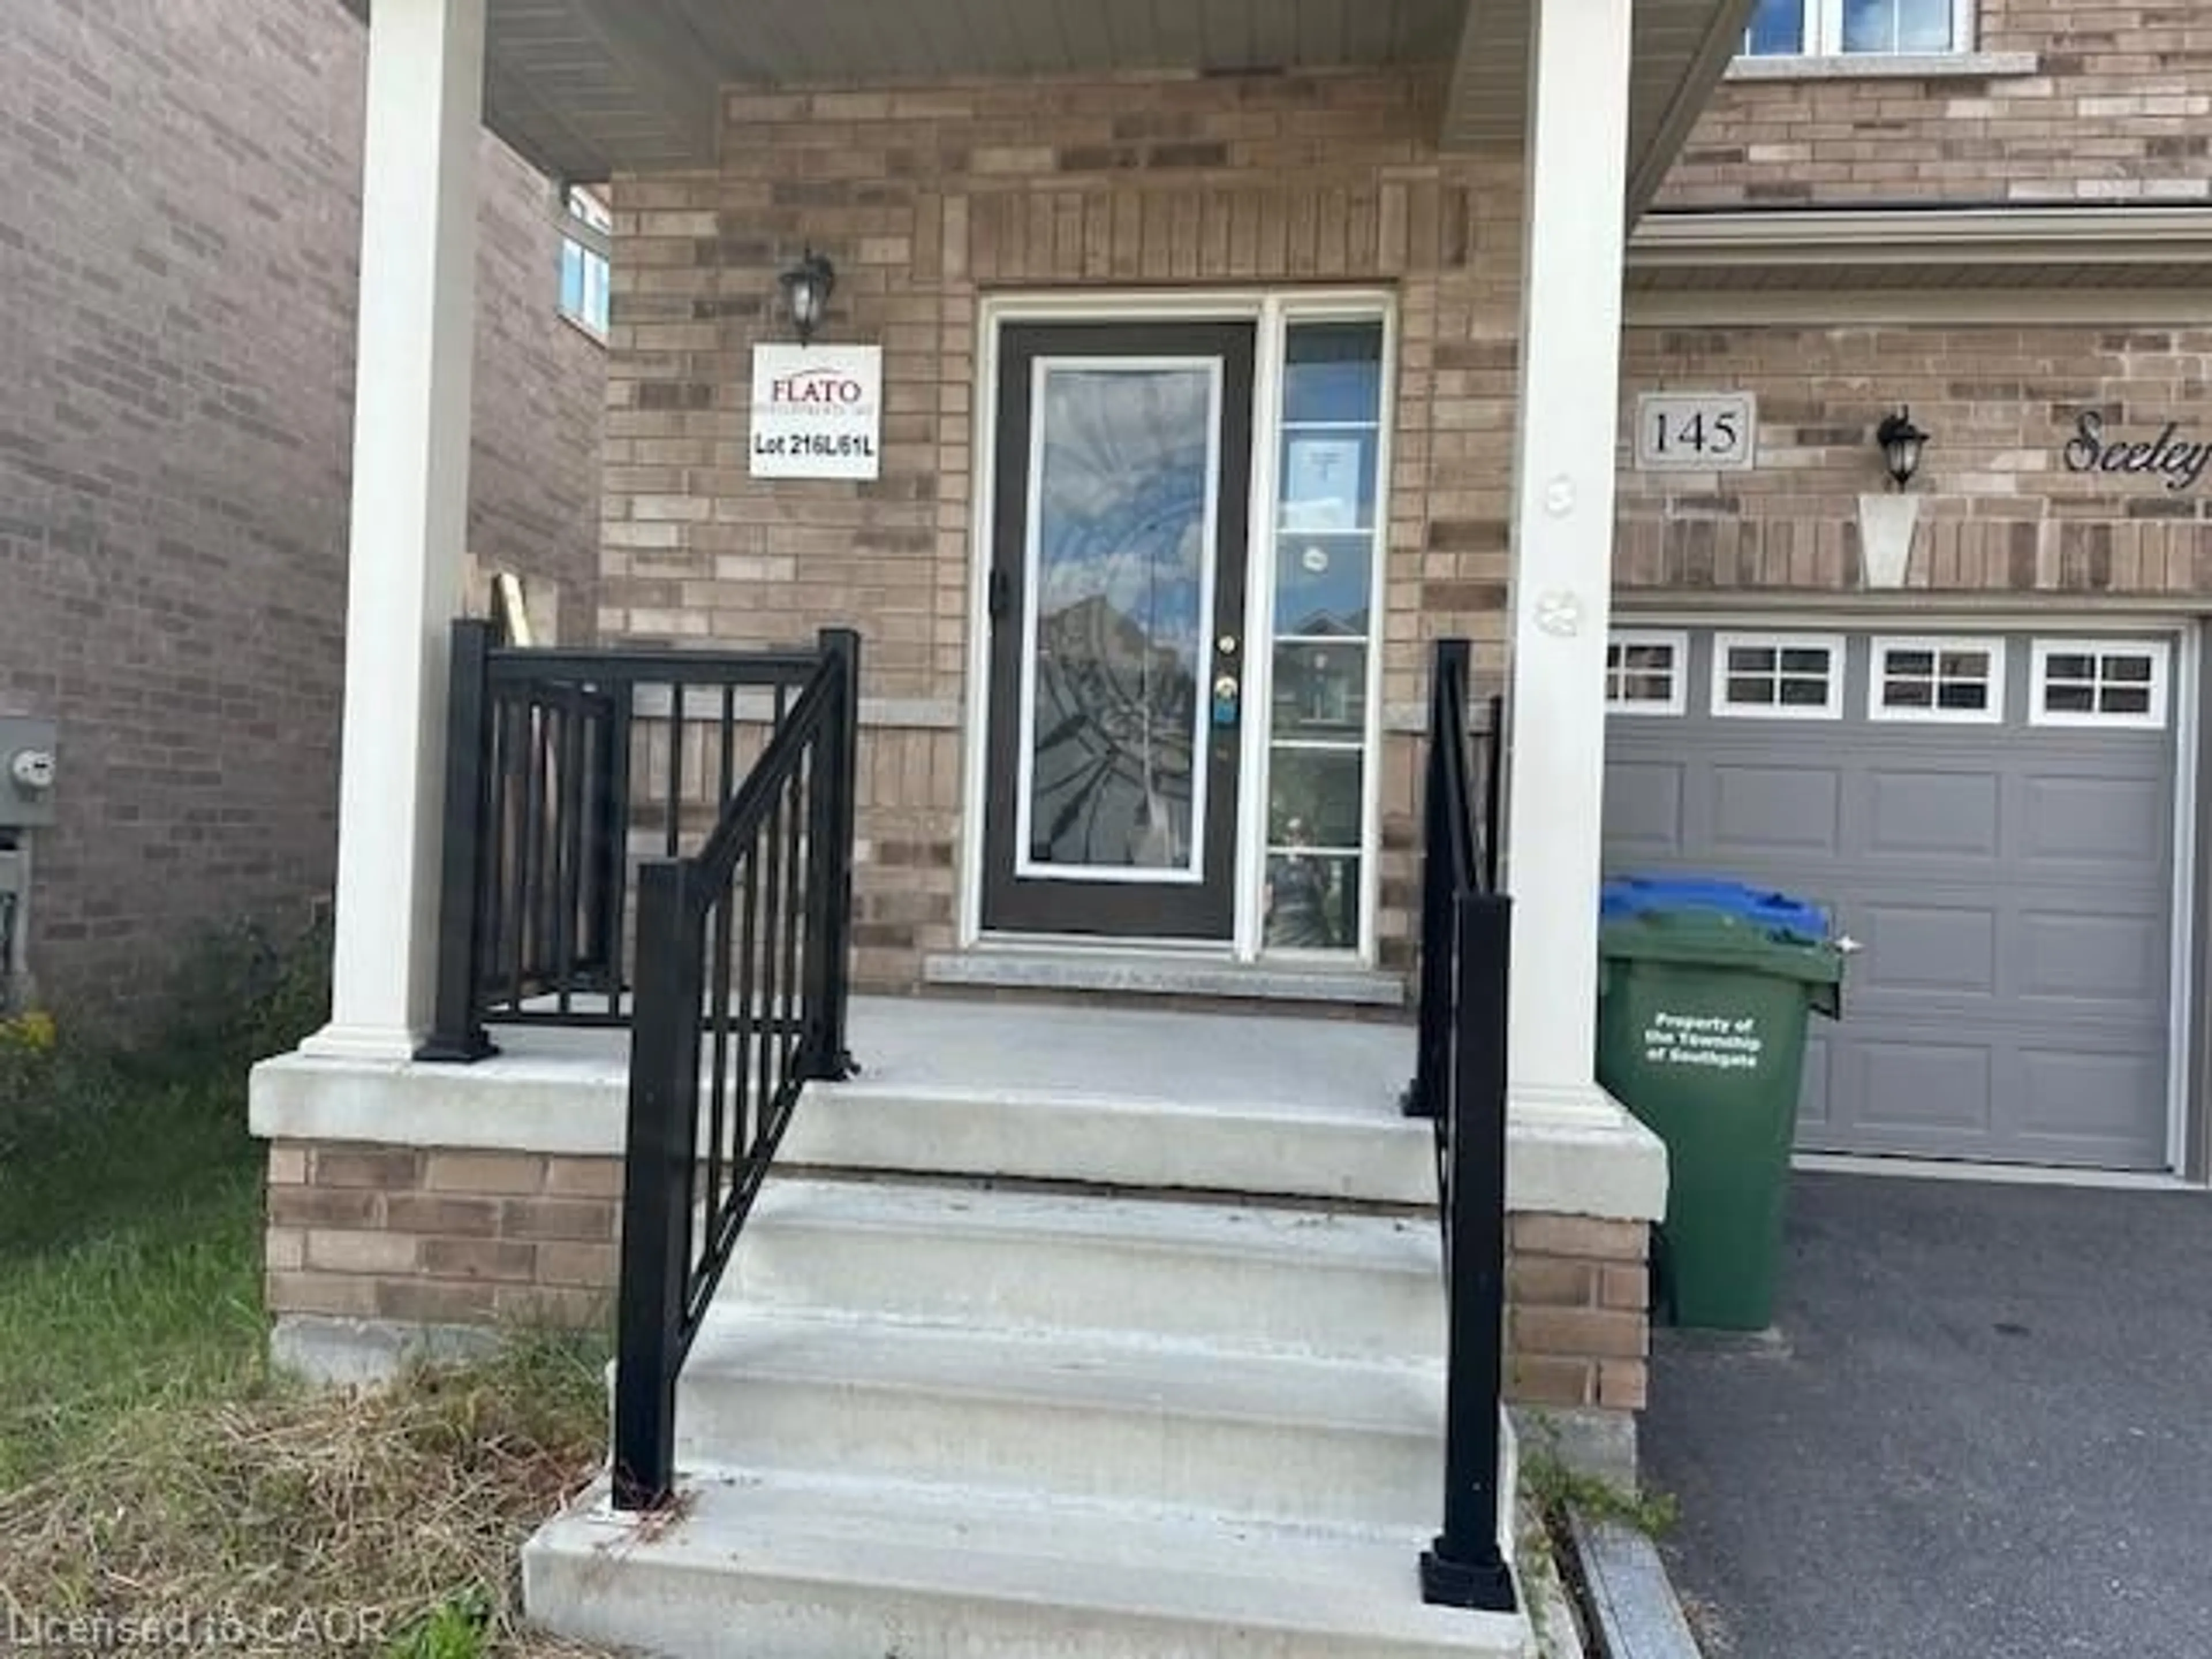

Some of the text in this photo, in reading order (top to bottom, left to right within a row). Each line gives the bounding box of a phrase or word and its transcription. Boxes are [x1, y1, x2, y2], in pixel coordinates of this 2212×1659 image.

[773, 379, 861, 402] FLATO
[1657, 410, 1736, 453] 145
[754, 433, 786, 455] Lot
[2064, 410, 2212, 490] Seeley
[1655, 1012, 1753, 1034] Property of
[1645, 1029, 1762, 1052] the Township
[1645, 1047, 1757, 1068] of Southgate
